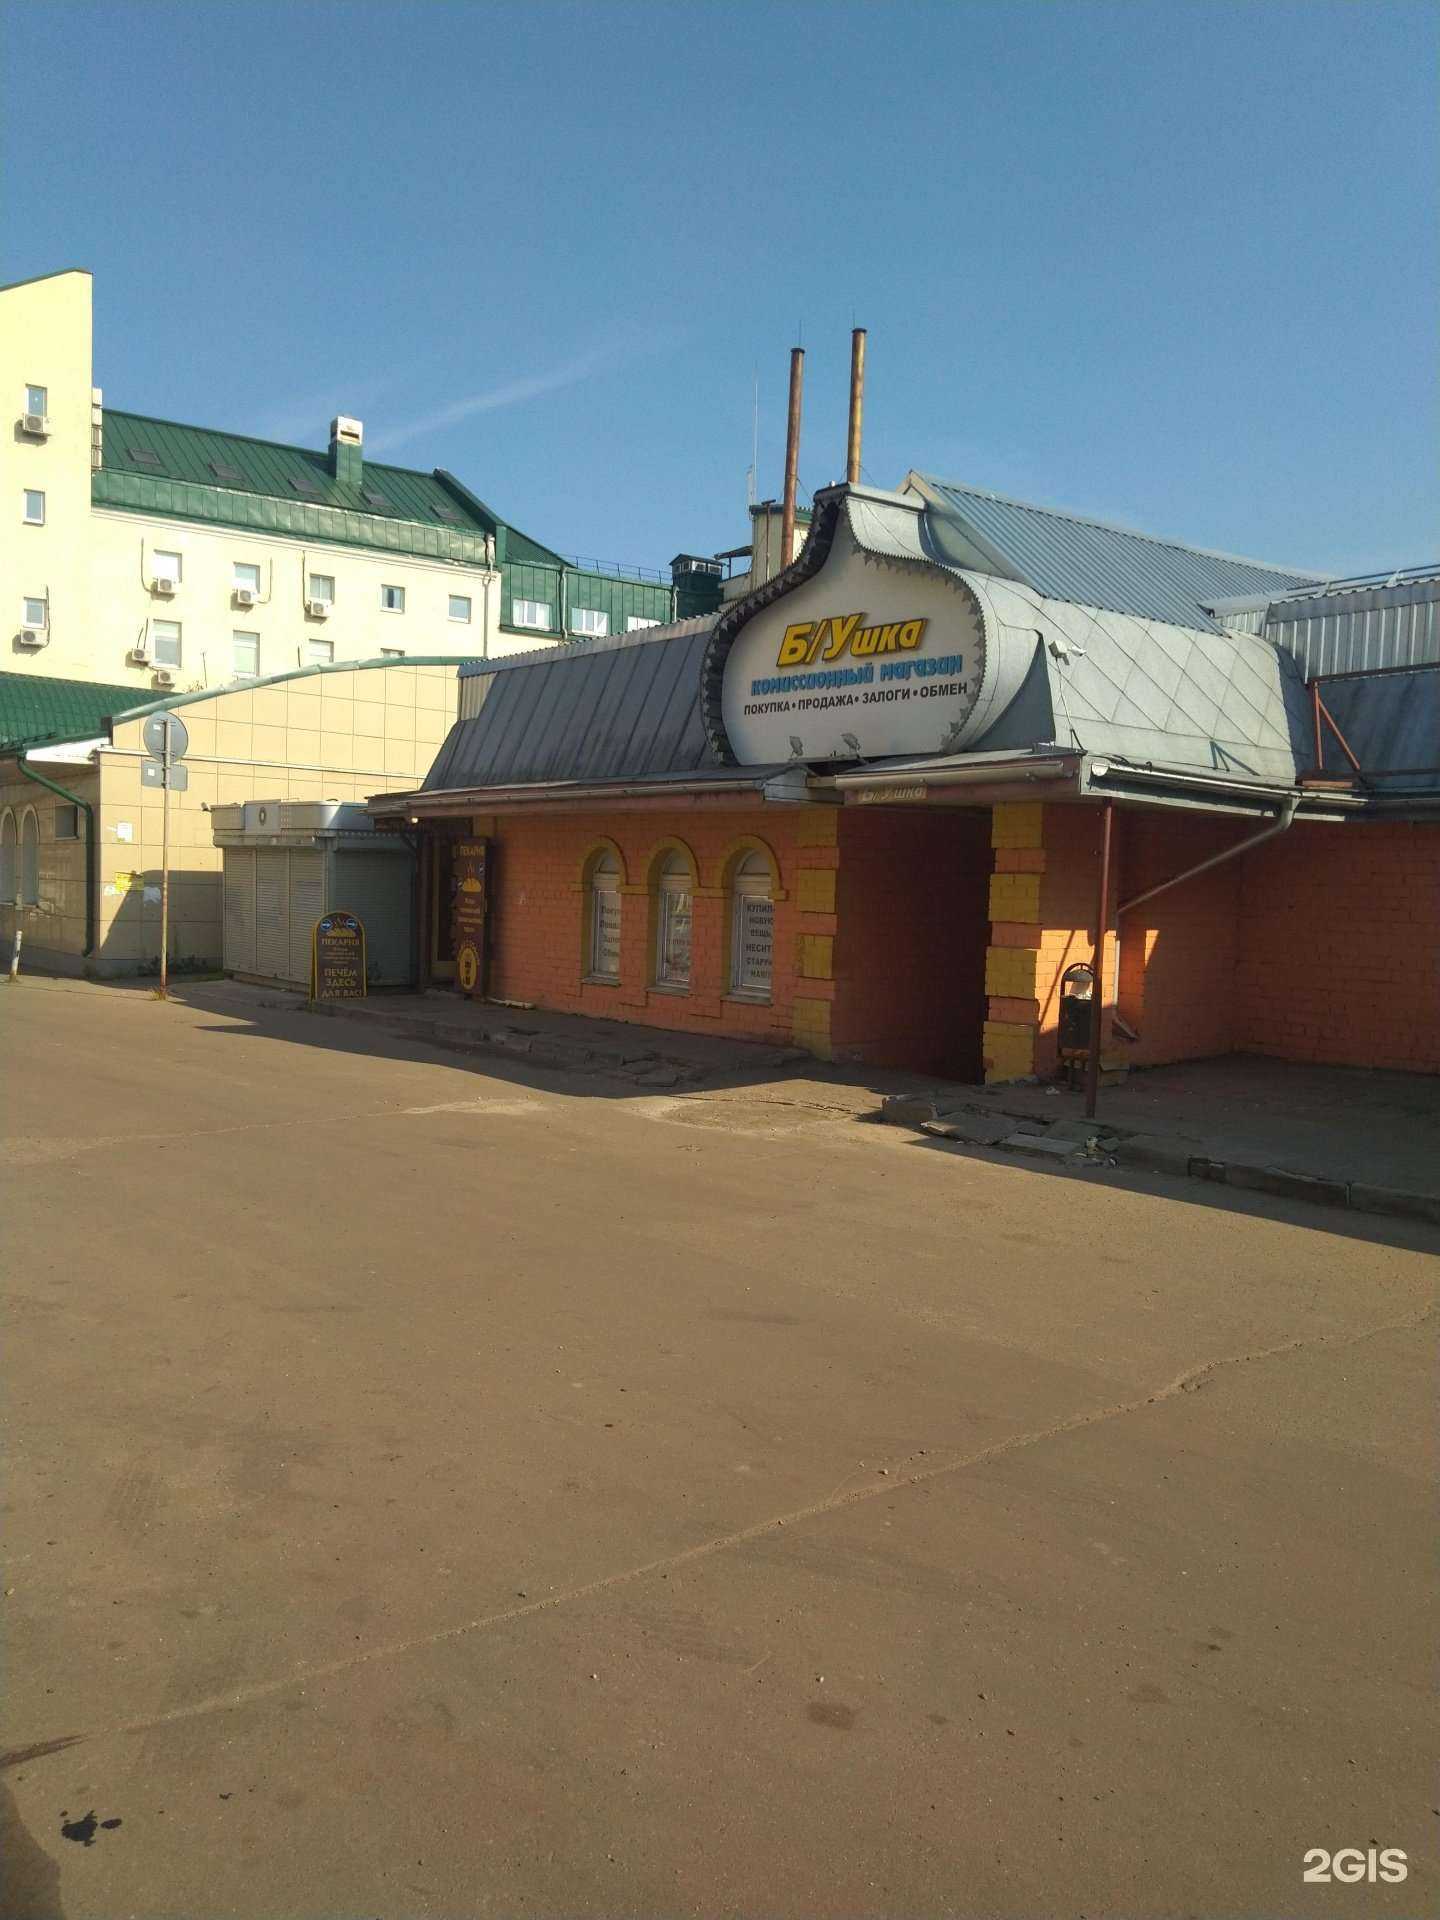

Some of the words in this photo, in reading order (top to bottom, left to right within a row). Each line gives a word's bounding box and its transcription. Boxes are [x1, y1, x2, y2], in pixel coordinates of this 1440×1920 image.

[777, 612, 928, 667] Б/Ушка
[744, 701, 790, 715] ПОКУПКА
[798, 695, 854, 710] ПРОДАЖА
[862, 688, 910, 704] ЗАЛОГИ
[920, 682, 968, 698] ОБМЕН
